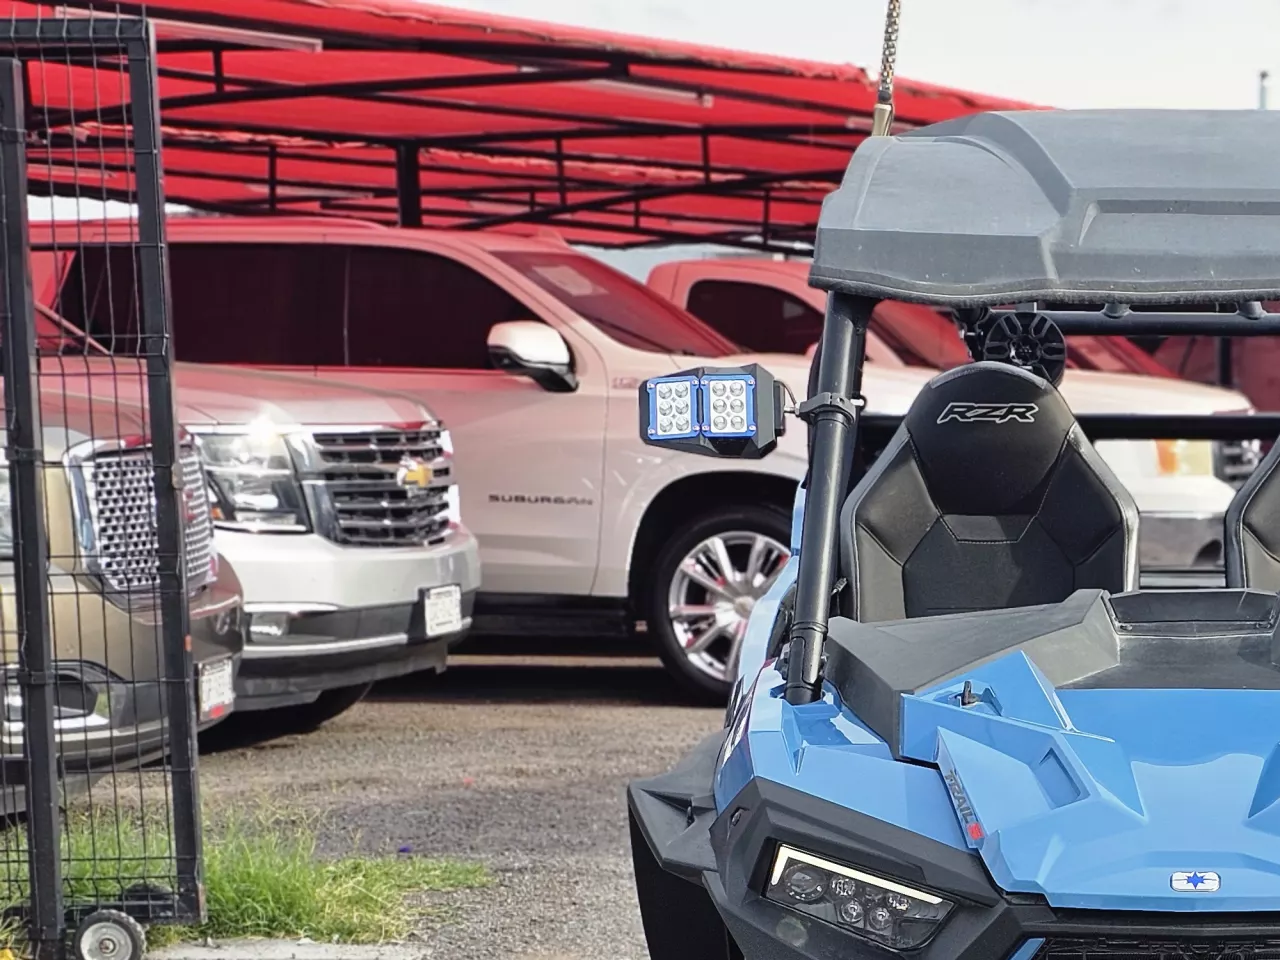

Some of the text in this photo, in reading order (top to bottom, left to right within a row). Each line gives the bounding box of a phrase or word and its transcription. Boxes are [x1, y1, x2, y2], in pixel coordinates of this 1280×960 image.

[937, 402, 1038, 424] RZR
[488, 493, 593, 506] SUBURBAN
[945, 769, 973, 824] TRAIL
